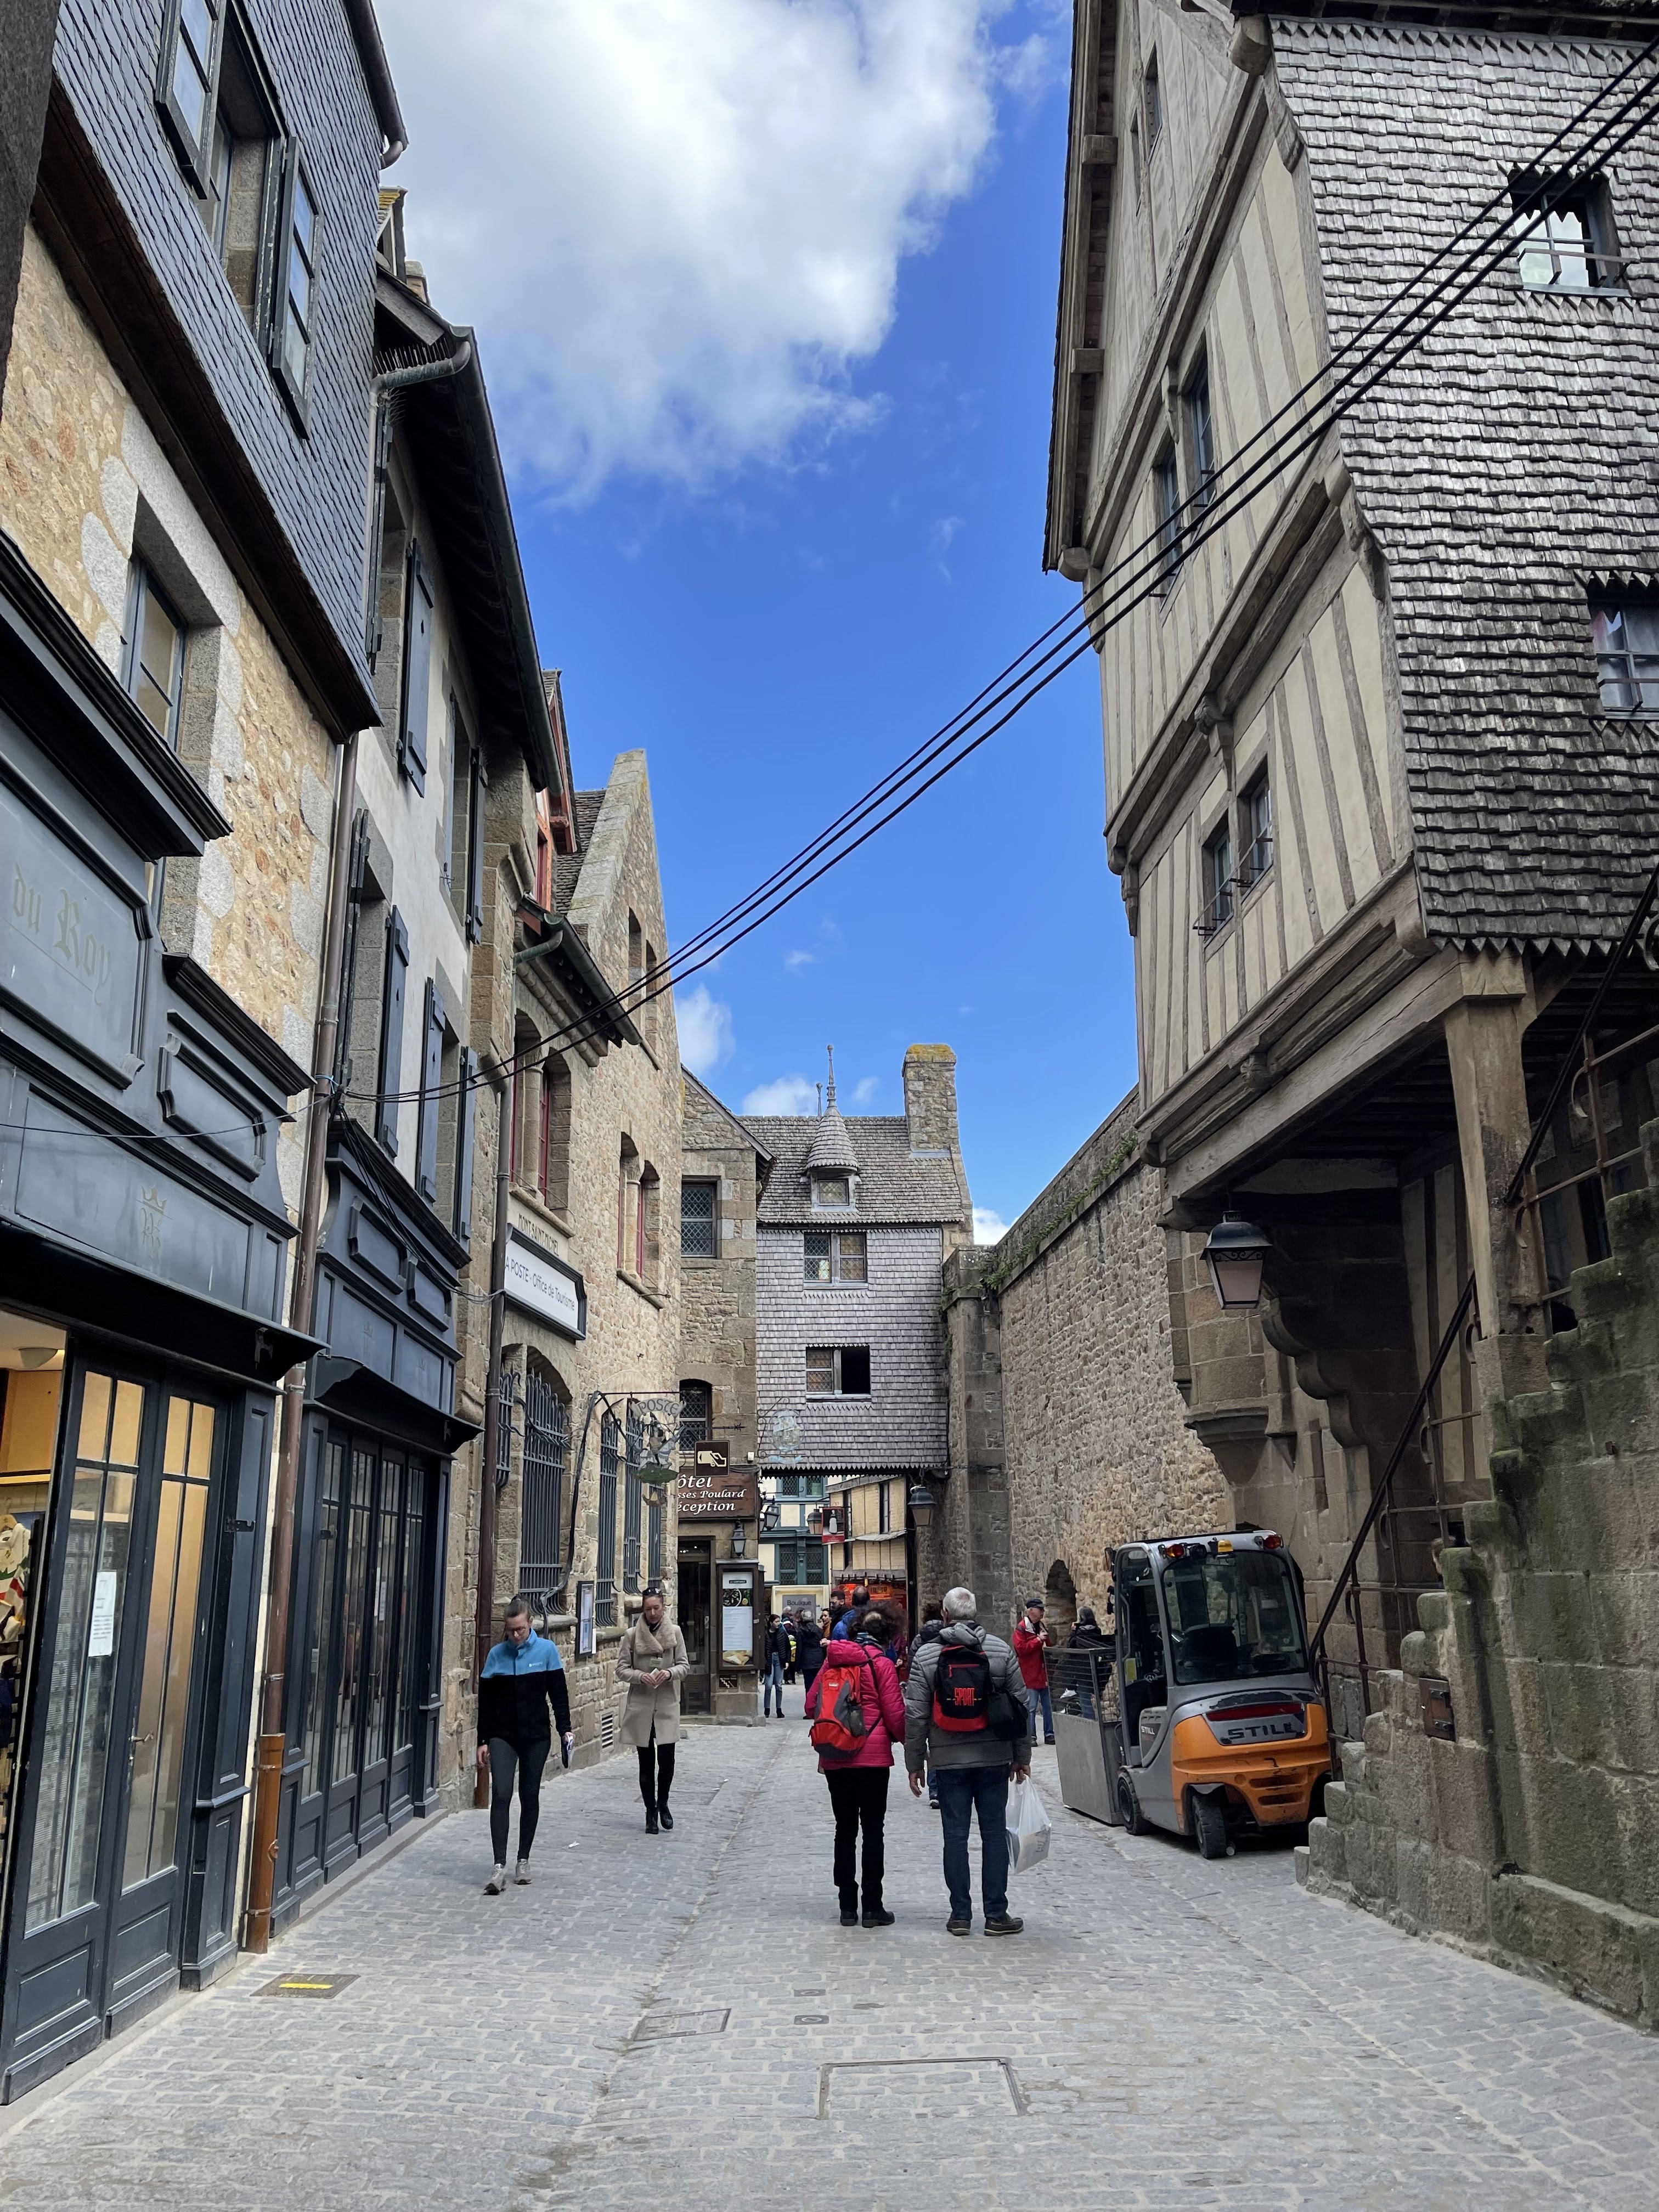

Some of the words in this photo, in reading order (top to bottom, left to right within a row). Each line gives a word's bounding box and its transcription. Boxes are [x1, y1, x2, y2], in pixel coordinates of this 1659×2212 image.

[14, 861, 41, 934] du
[54, 887, 111, 1006] Roy
[511, 1259, 529, 1283] POSTE
[533, 1273, 547, 1294] Office
[548, 1283, 554, 1299] de
[555, 1287, 575, 1311] Tourisme
[637, 1398, 680, 1415] POSTE
[678, 1474, 713, 1488] ôtel
[700, 1489, 747, 1499] Poulard
[678, 1500, 736, 1515] éception
[955, 1688, 975, 1706] SPORT
[1141, 1726, 1155, 1735] STILL
[1227, 1722, 1297, 1740] STILL
